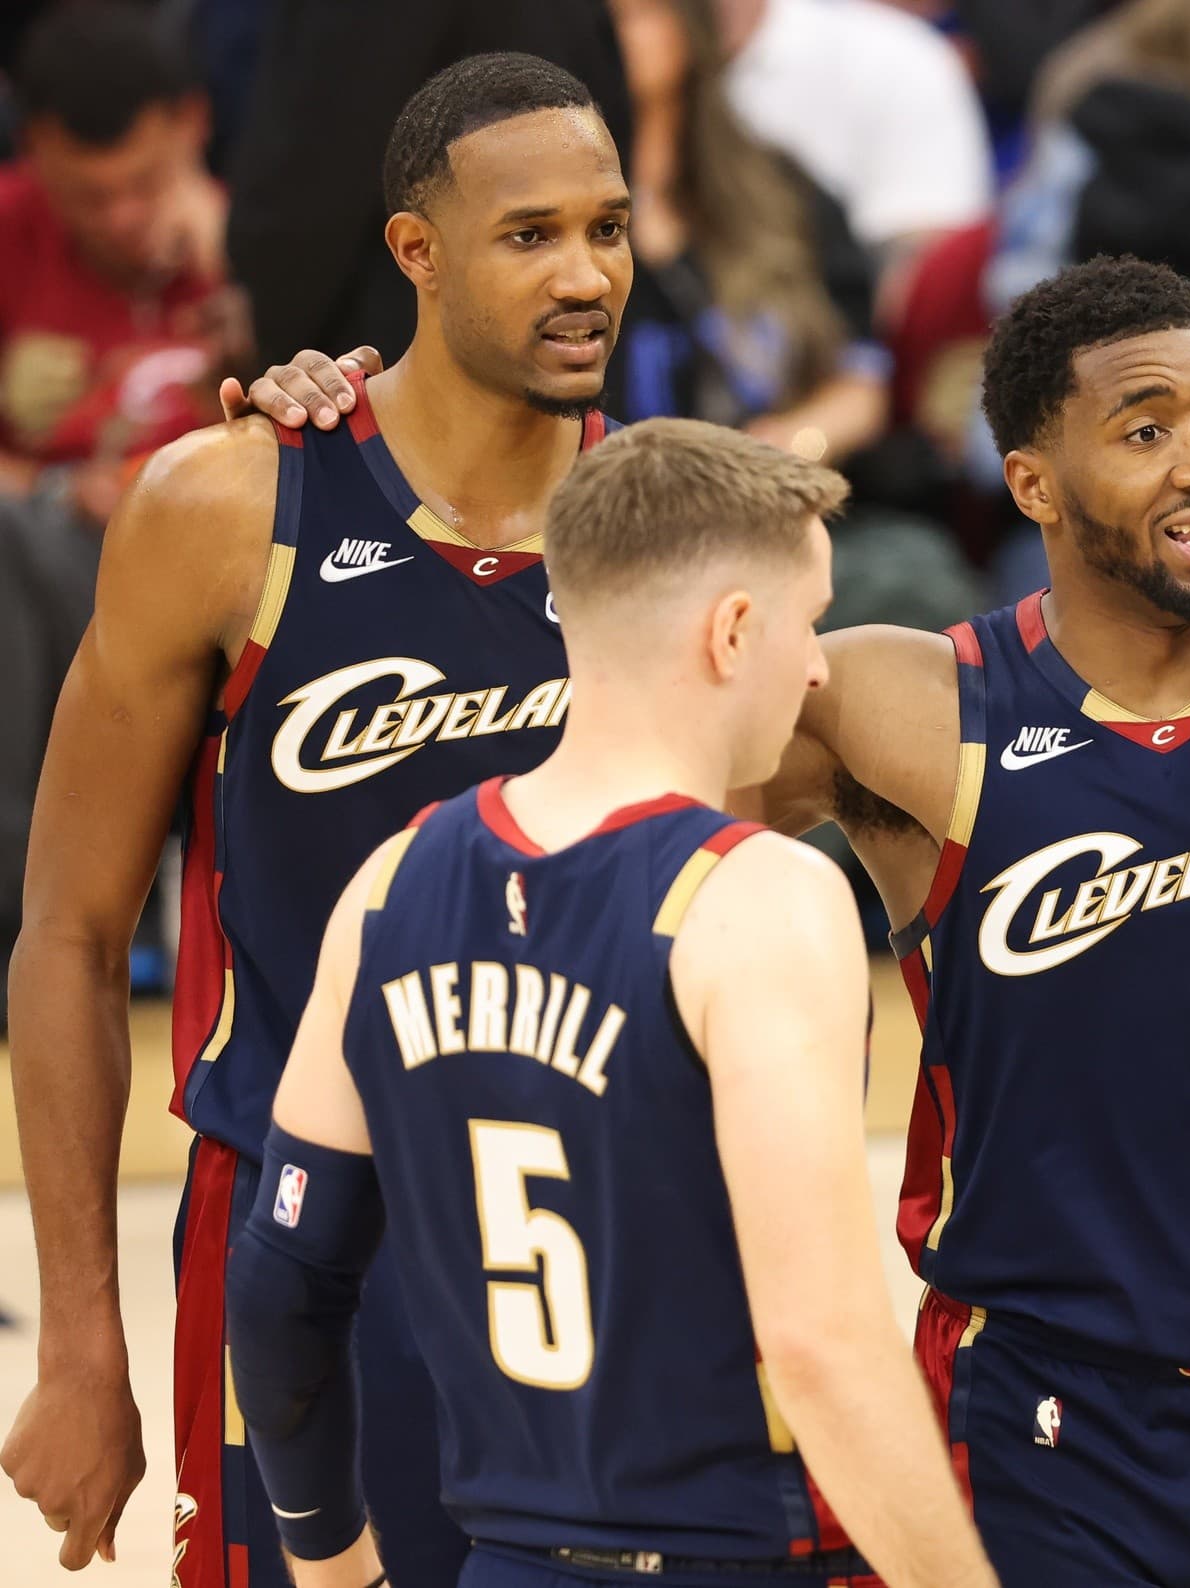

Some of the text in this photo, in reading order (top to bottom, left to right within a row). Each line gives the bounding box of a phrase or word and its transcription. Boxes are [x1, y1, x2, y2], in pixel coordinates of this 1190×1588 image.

[334, 538, 391, 566] NIKE
[472, 557, 499, 576] C
[270, 656, 572, 794] CLEVELA
[1014, 726, 1071, 752] NIKE
[1151, 725, 1177, 745] C
[381, 960, 628, 1098] MERRILL
[467, 1118, 595, 1391] 5
